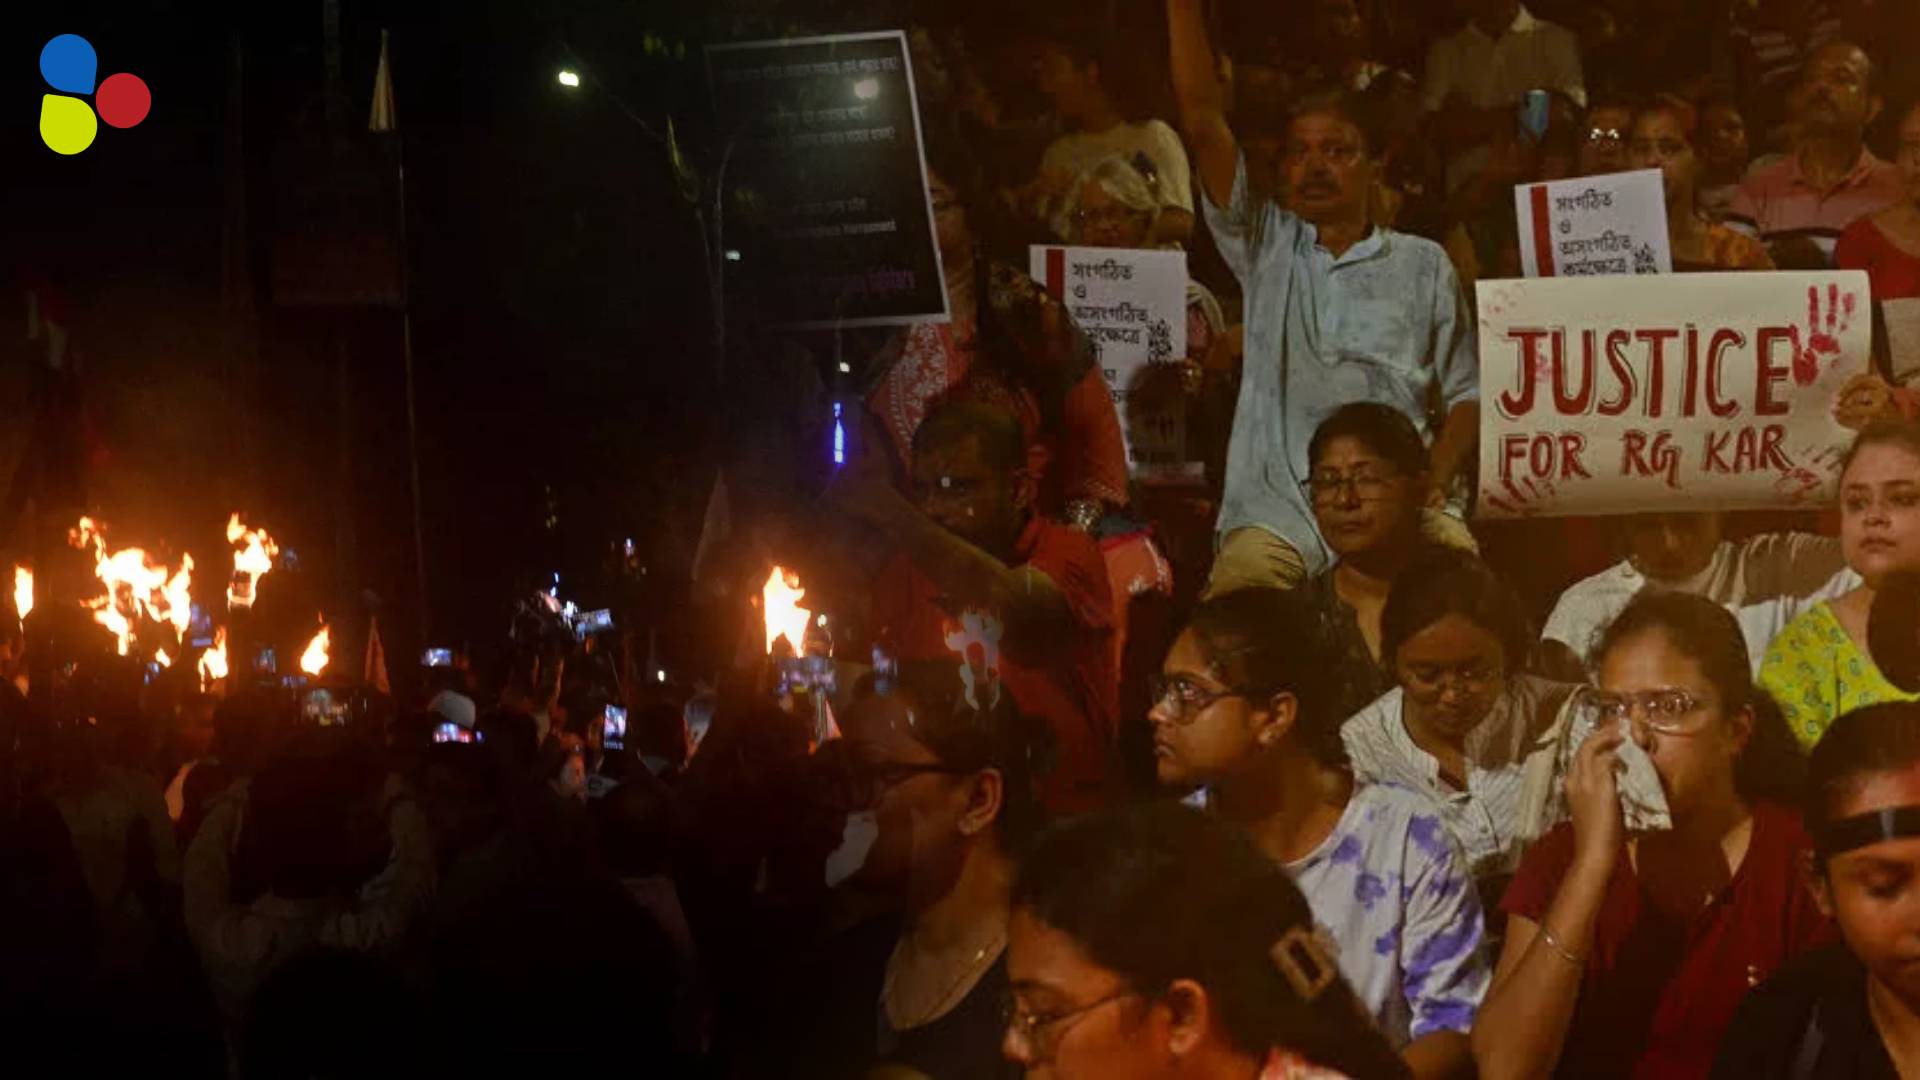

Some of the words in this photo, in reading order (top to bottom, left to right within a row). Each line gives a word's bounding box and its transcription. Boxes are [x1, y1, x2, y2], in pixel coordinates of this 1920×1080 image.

[1556, 189, 1613, 212] সংগঠিত
[1559, 219, 1572, 234] ও
[1560, 230, 1633, 256] অসংগঠিত
[1072, 258, 1134, 280] সংগঠিত
[1072, 283, 1086, 298] ও
[1073, 302, 1148, 323] অসংগঠিত
[1496, 323, 1793, 420] JUSTICE
[1498, 429, 1592, 481] FOR
[1619, 426, 1682, 489] RG
[1701, 423, 1792, 474] KAR
